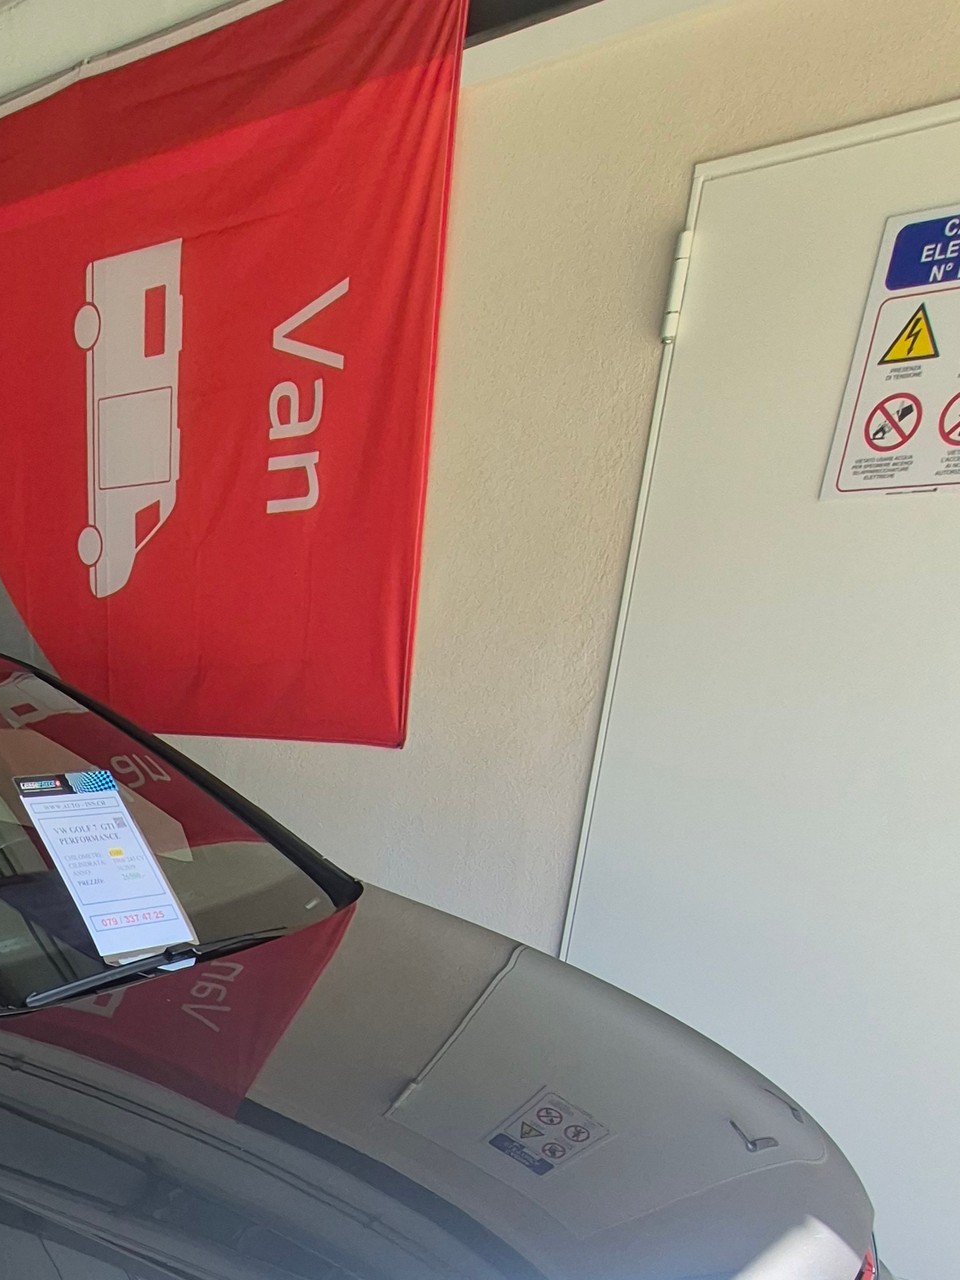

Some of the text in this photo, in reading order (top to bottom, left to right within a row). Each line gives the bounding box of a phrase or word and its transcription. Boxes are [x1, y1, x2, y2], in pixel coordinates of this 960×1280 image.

[944, 218, 960, 237] C
[266, 276, 350, 514] Van
[69, 824, 91, 834] GOLF
[59, 832, 121, 846] PERFORMANCE
[101, 917, 118, 927] 079
[124, 914, 139, 924] 337
[142, 912, 151, 921] 47
[153, 910, 165, 919] 25
